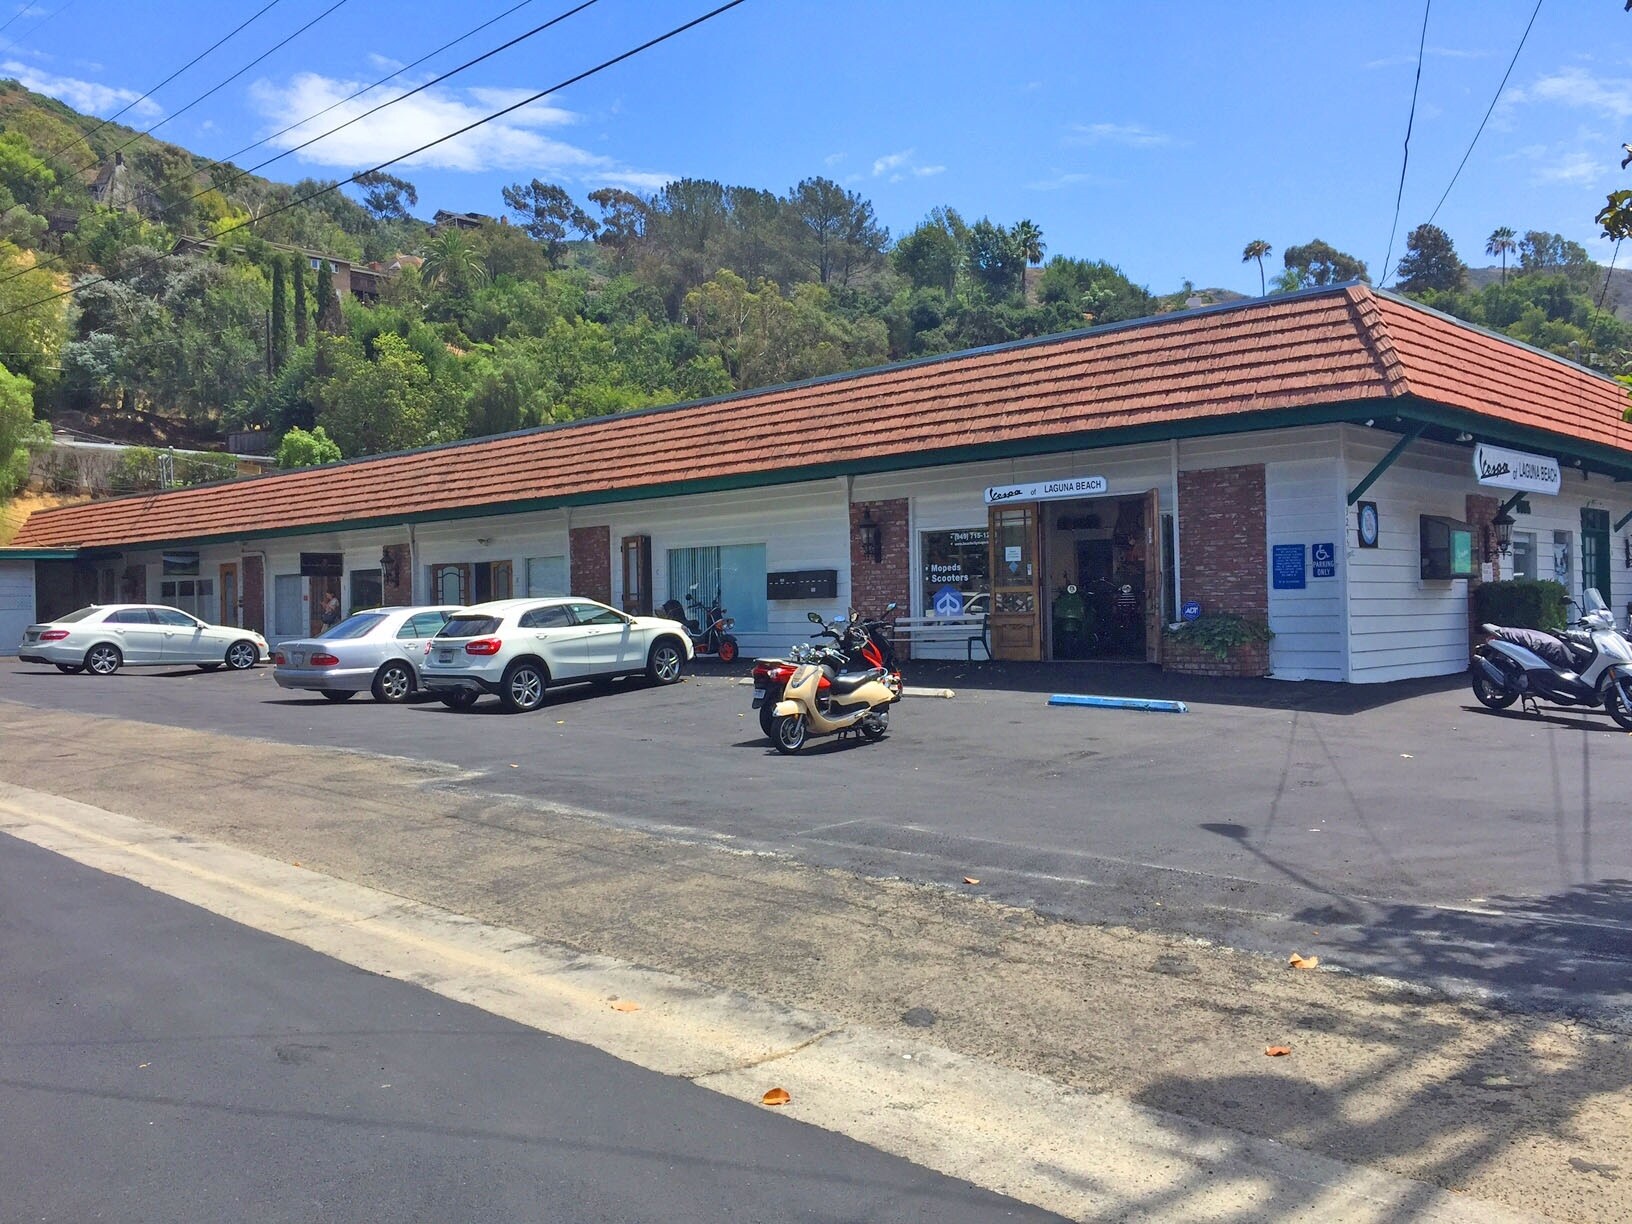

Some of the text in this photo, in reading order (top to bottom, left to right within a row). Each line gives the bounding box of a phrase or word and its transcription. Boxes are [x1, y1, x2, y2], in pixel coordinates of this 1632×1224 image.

[1479, 447, 1558, 483] Vespa of LAGUNA BEACH
[989, 488, 1023, 502] Vespa
[1044, 482, 1074, 494] LAGUNA
[1075, 480, 1102, 491] BEACH
[931, 563, 961, 573] Mopeds
[1312, 560, 1335, 568] PARKING
[1316, 568, 1331, 576] ONLY
[931, 574, 969, 583] Scooters
[1184, 606, 1199, 614] ADT
